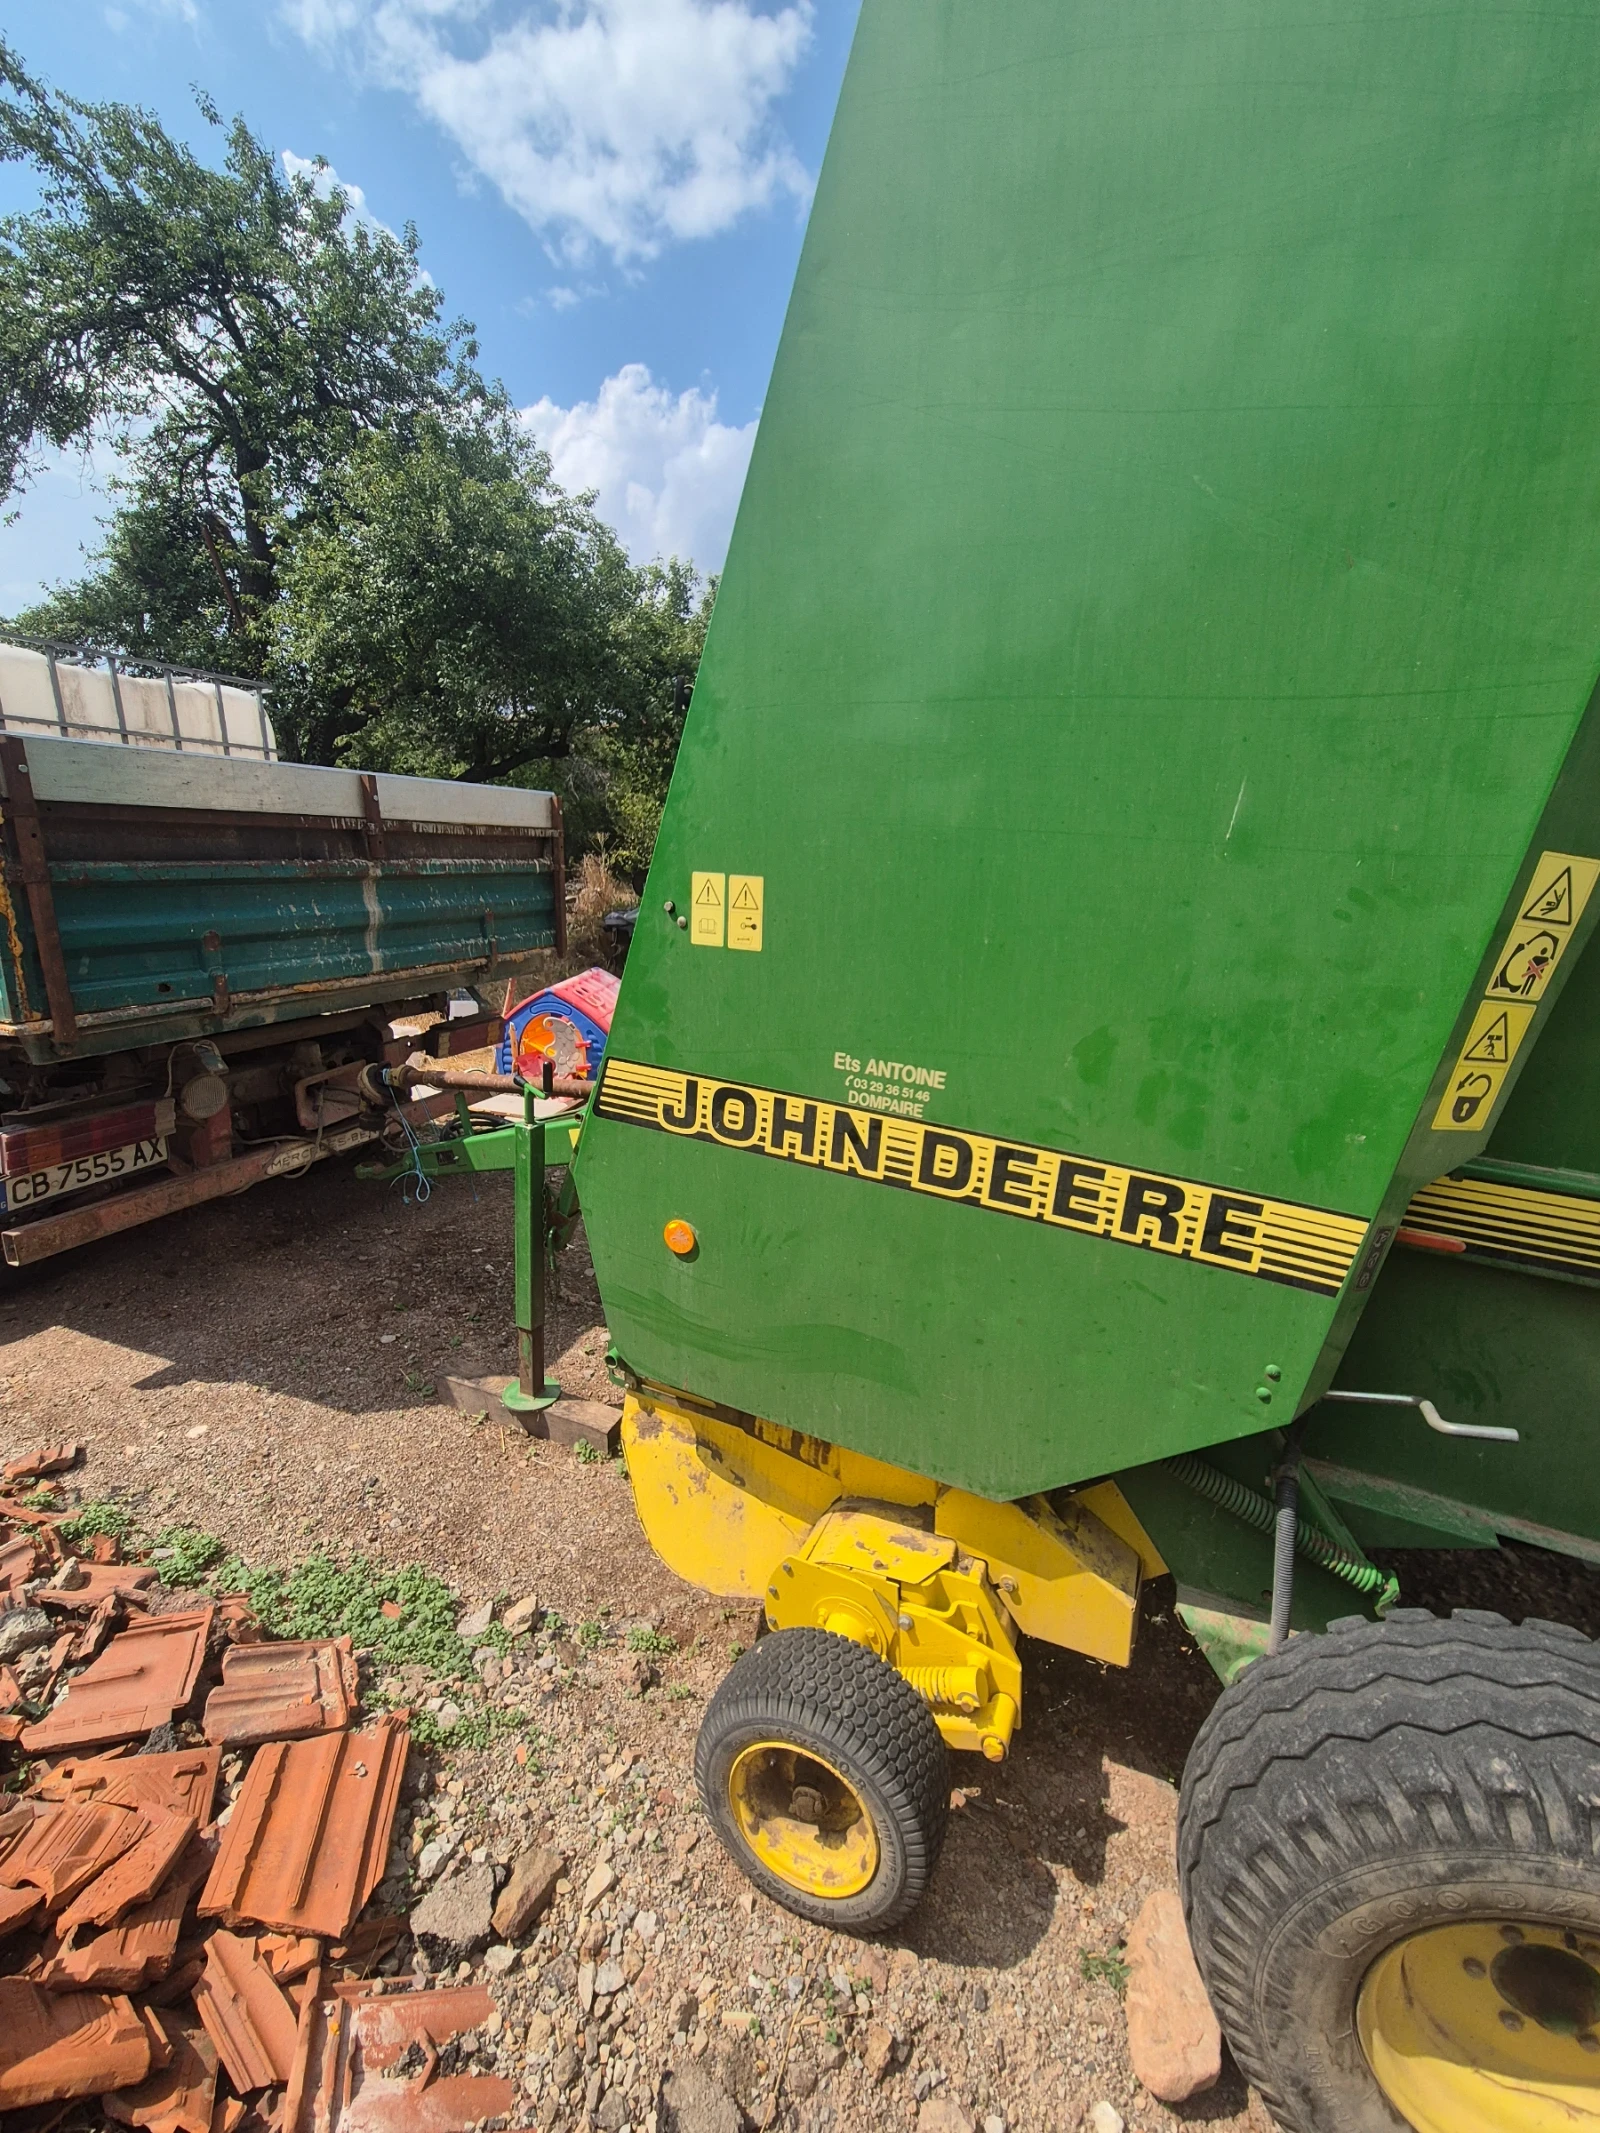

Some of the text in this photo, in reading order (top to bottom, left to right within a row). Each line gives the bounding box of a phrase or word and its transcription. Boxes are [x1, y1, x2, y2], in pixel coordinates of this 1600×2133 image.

[834, 1052, 947, 1089] Ets ANTOINE
[848, 1090, 924, 1118] DOMPAIRE
[853, 1077, 930, 1102] 03 29 36 51 46
[12, 1137, 163, 1204] CB 7555 AX
[659, 1079, 884, 1178] JOHN
[917, 1129, 1265, 1270] DEERE
